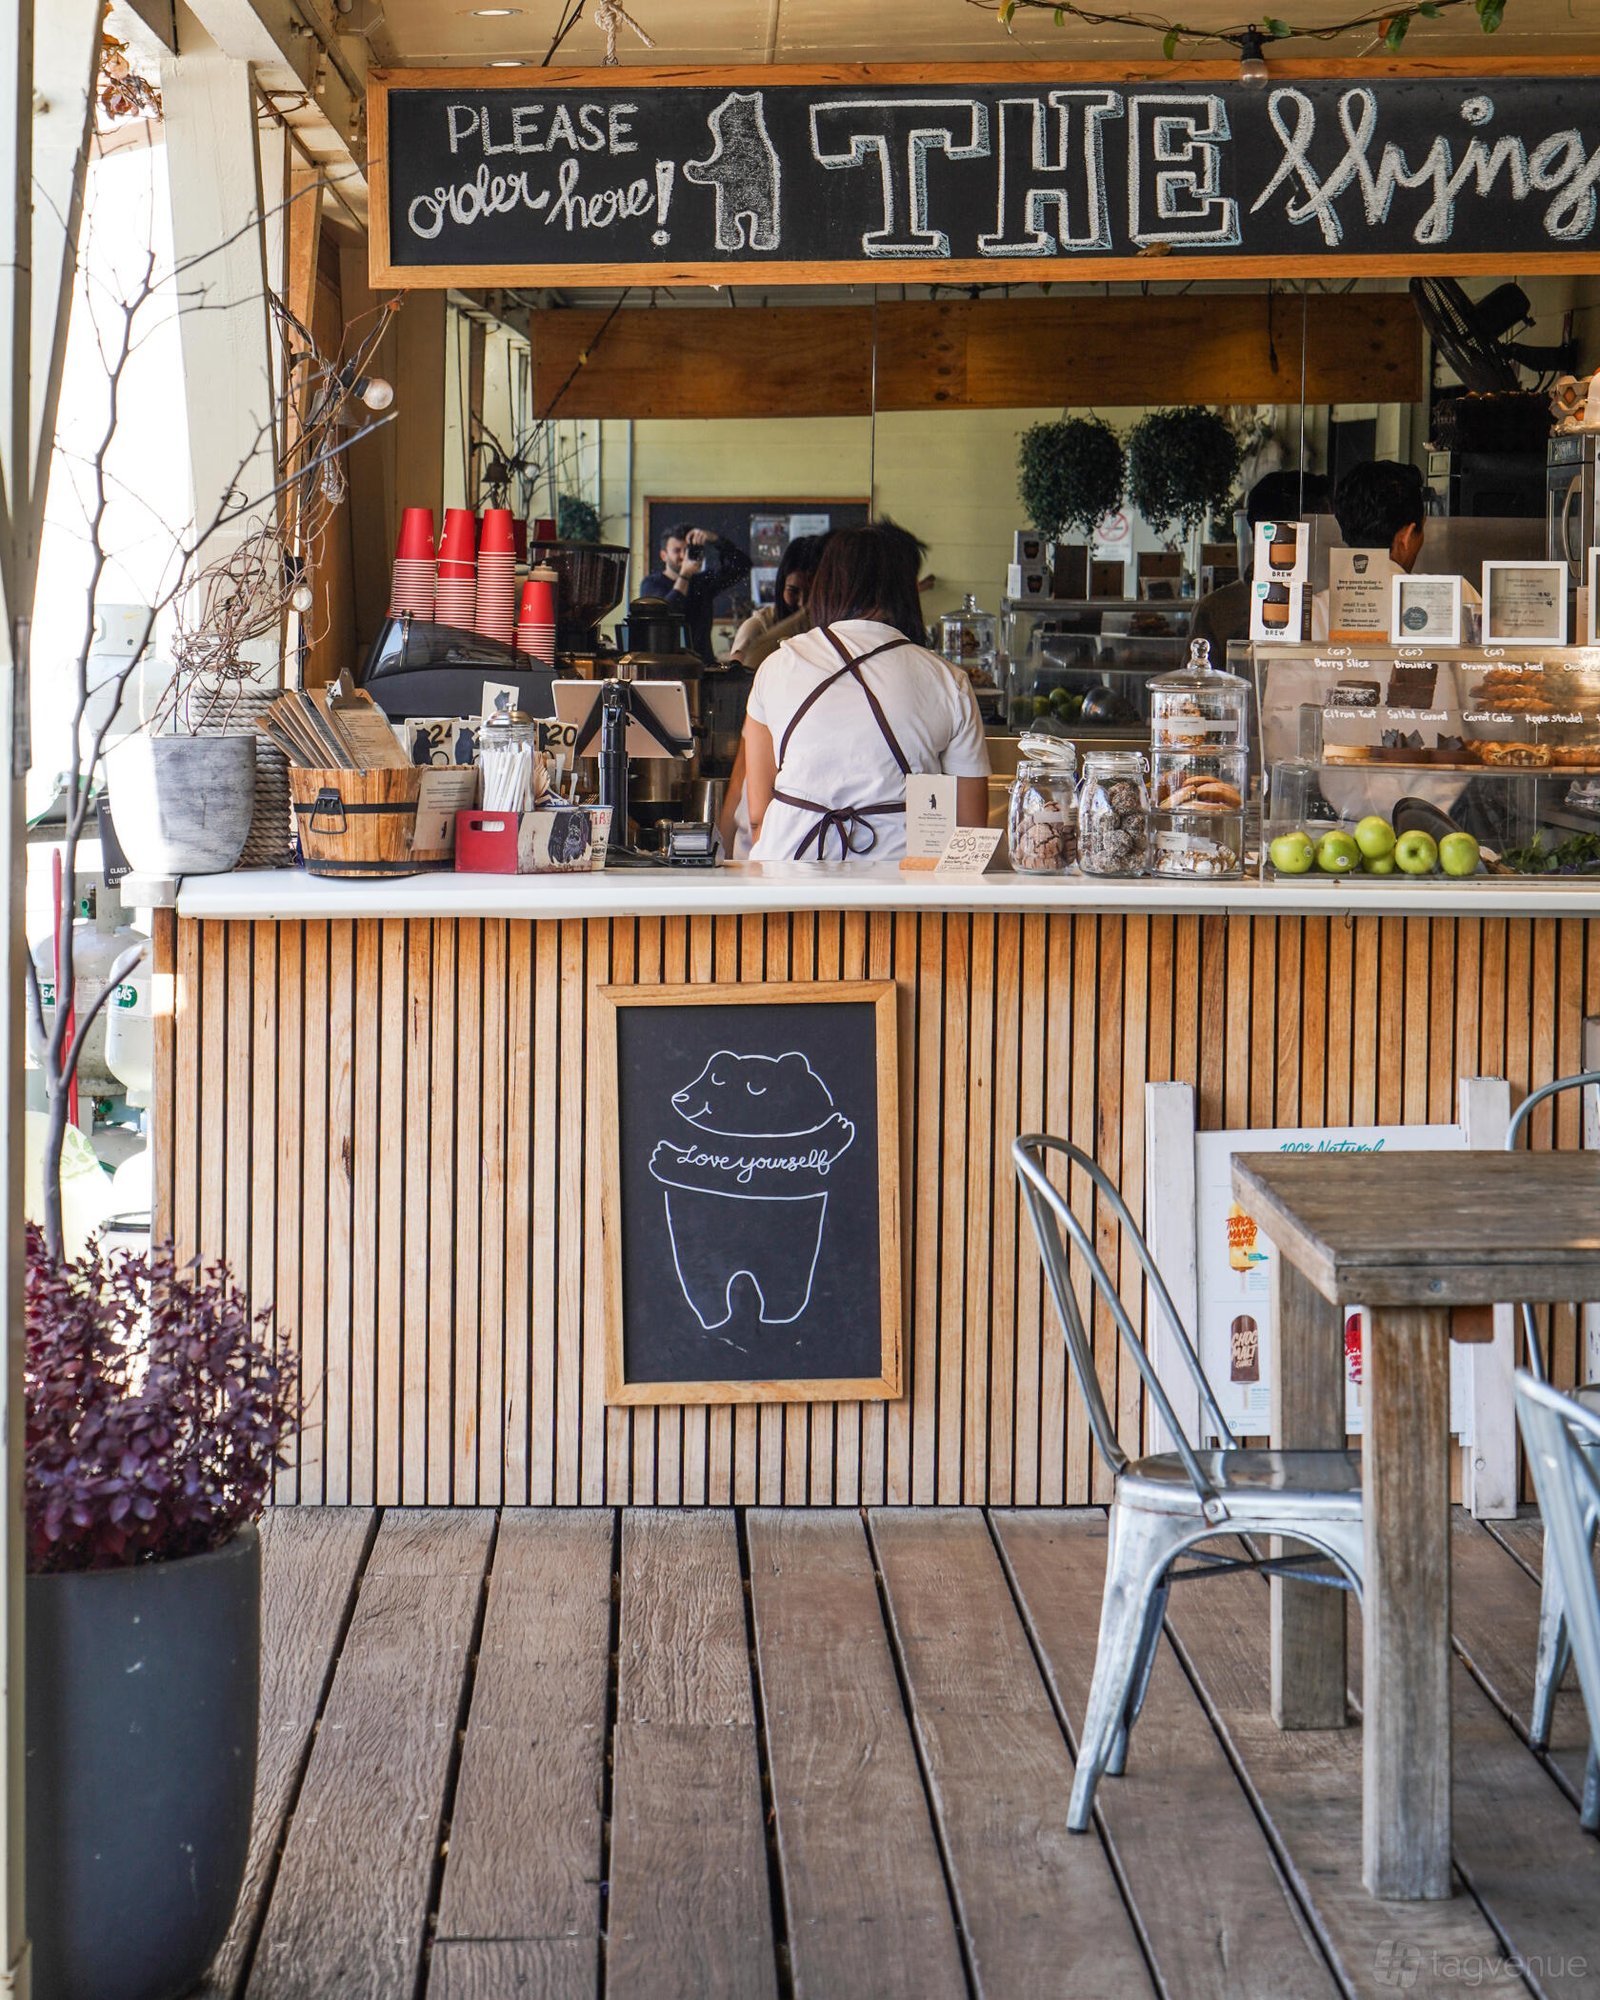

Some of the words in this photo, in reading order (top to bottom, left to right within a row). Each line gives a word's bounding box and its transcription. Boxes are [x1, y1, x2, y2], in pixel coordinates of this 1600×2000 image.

[447, 103, 639, 155] PLEASE
[809, 90, 1242, 257] THE
[408, 170, 549, 239] order
[545, 159, 675, 246] here!
[1314, 658, 1344, 671] Berry
[1346, 658, 1370, 668] Slice
[1394, 660, 1433, 670] Brownie
[1358, 710, 1377, 719] Tart
[1387, 710, 1416, 720] Salted
[1463, 712, 1490, 723] Carrot
[1525, 713, 1550, 724] Apple
[550, 724, 578, 747] 20
[41, 986, 55, 998] GA
[676, 1144, 730, 1170] Love
[736, 1149, 831, 1184] yourself
[1232, 1330, 1258, 1346] CHOC
[1232, 1344, 1258, 1360] MALT
